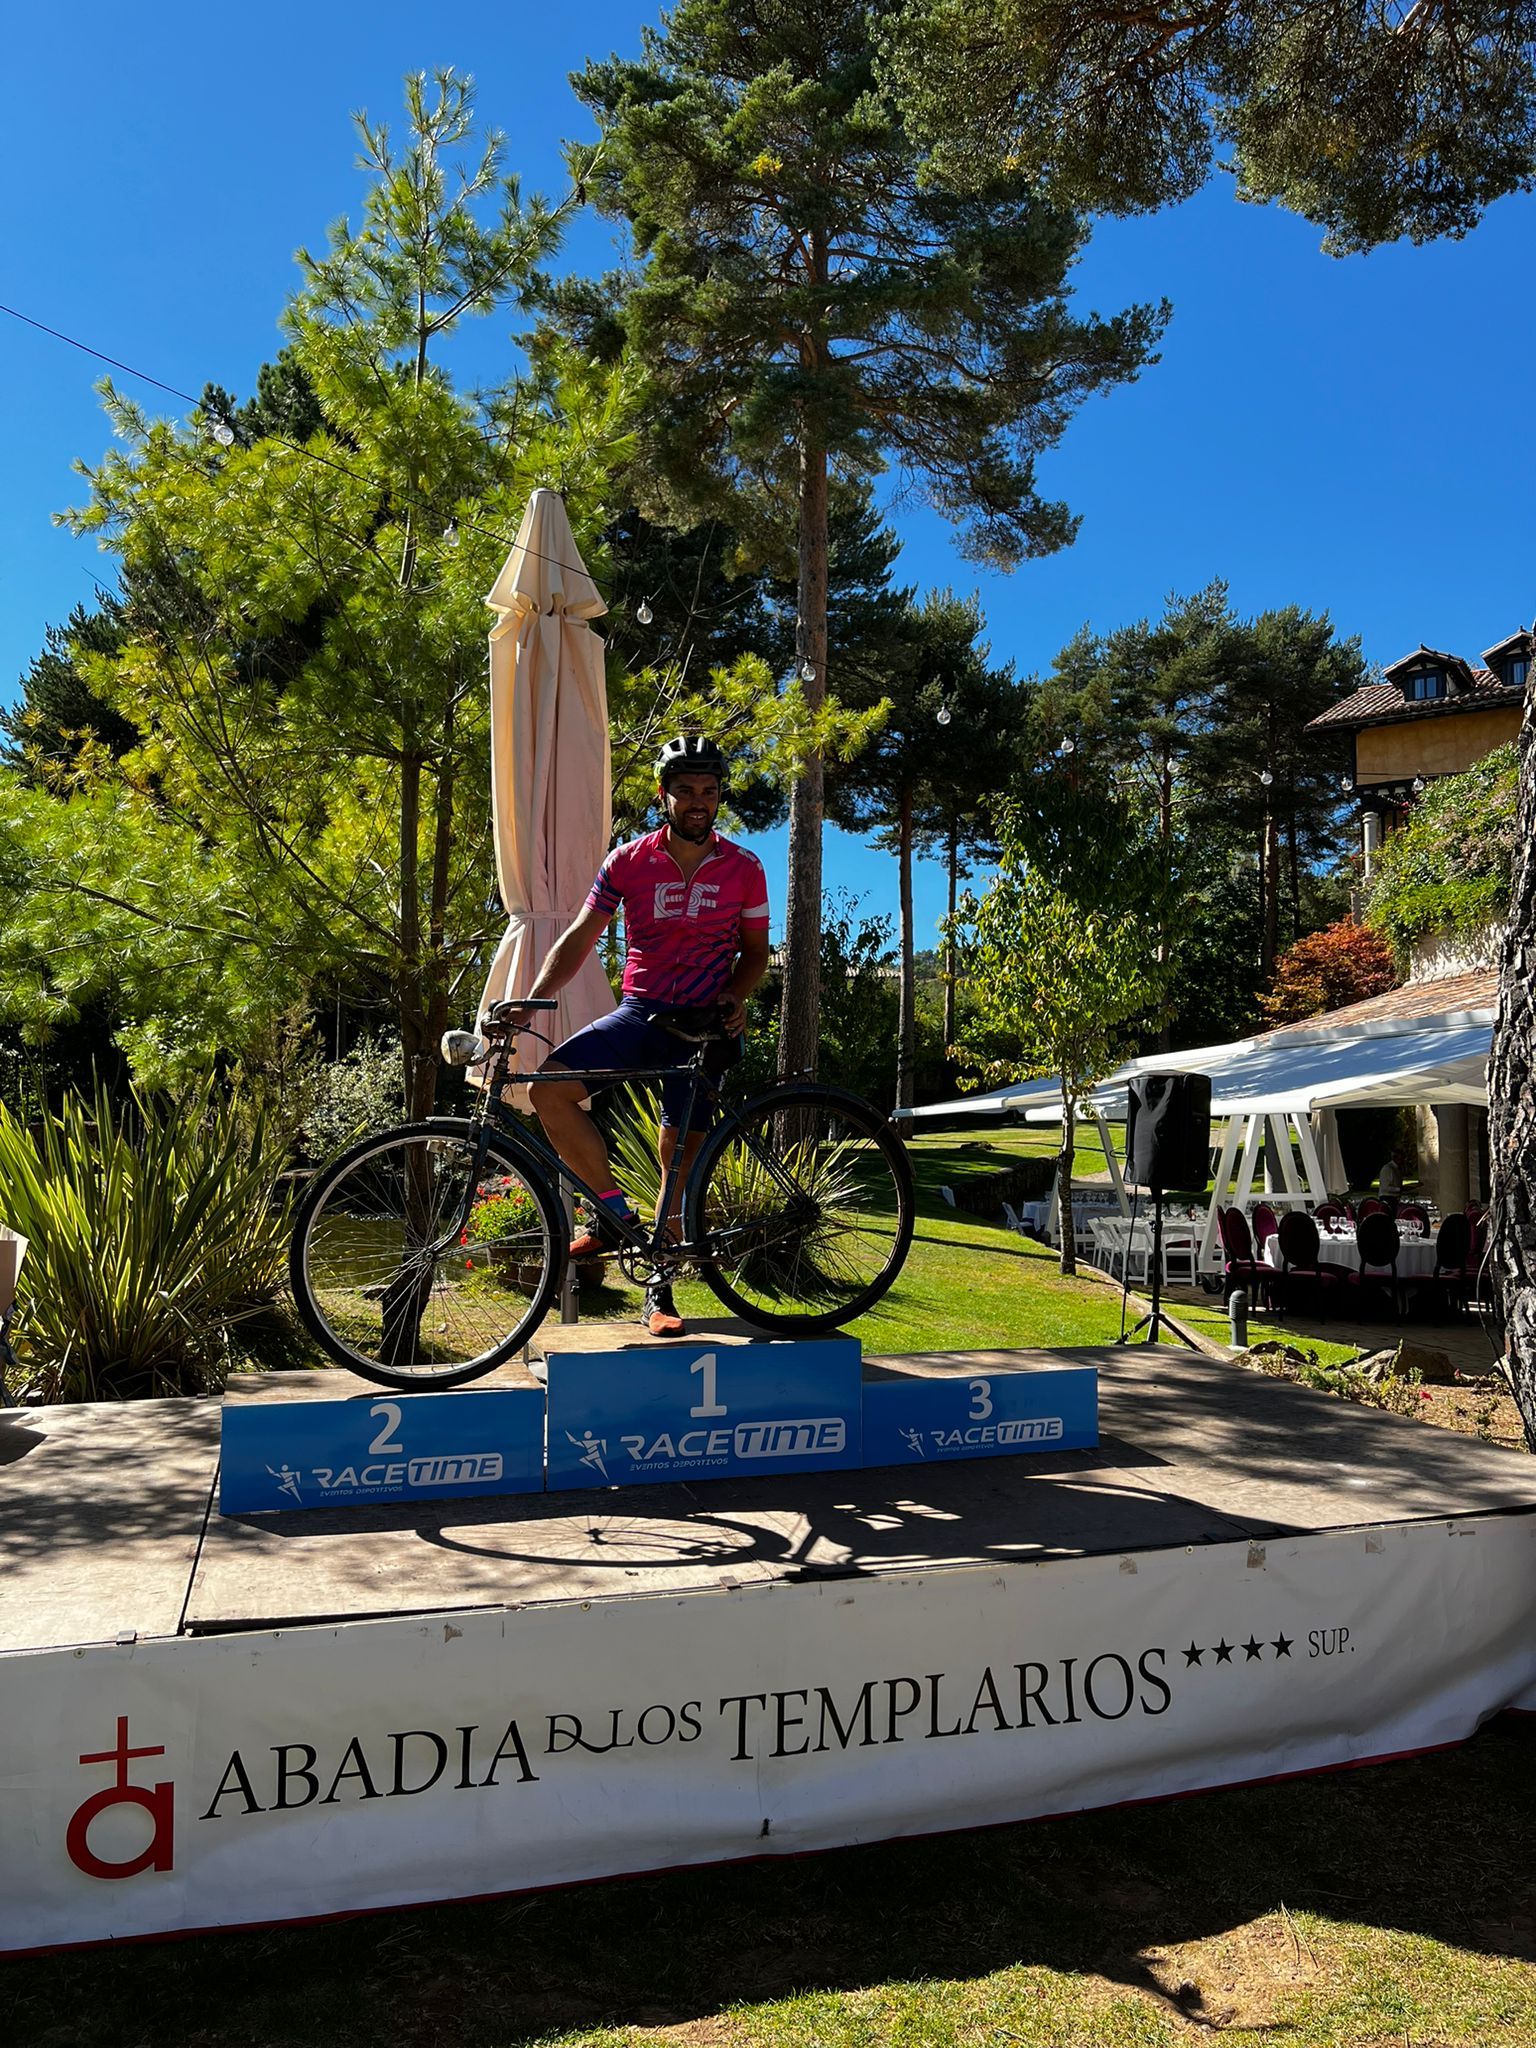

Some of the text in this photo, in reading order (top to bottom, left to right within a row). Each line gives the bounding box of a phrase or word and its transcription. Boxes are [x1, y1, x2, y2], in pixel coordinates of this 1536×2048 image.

[653, 882, 720, 918] EF
[690, 1353, 728, 1419] 1
[968, 1379, 993, 1420] 3
[368, 1402, 404, 1456] 2
[630, 1458, 728, 1472] EVENTOS DEPORTIVOS
[198, 1720, 541, 1821] ABADIA
[720, 1648, 1172, 1762] TEMPLARIOS
[1307, 1627, 1356, 1659] SUP.
